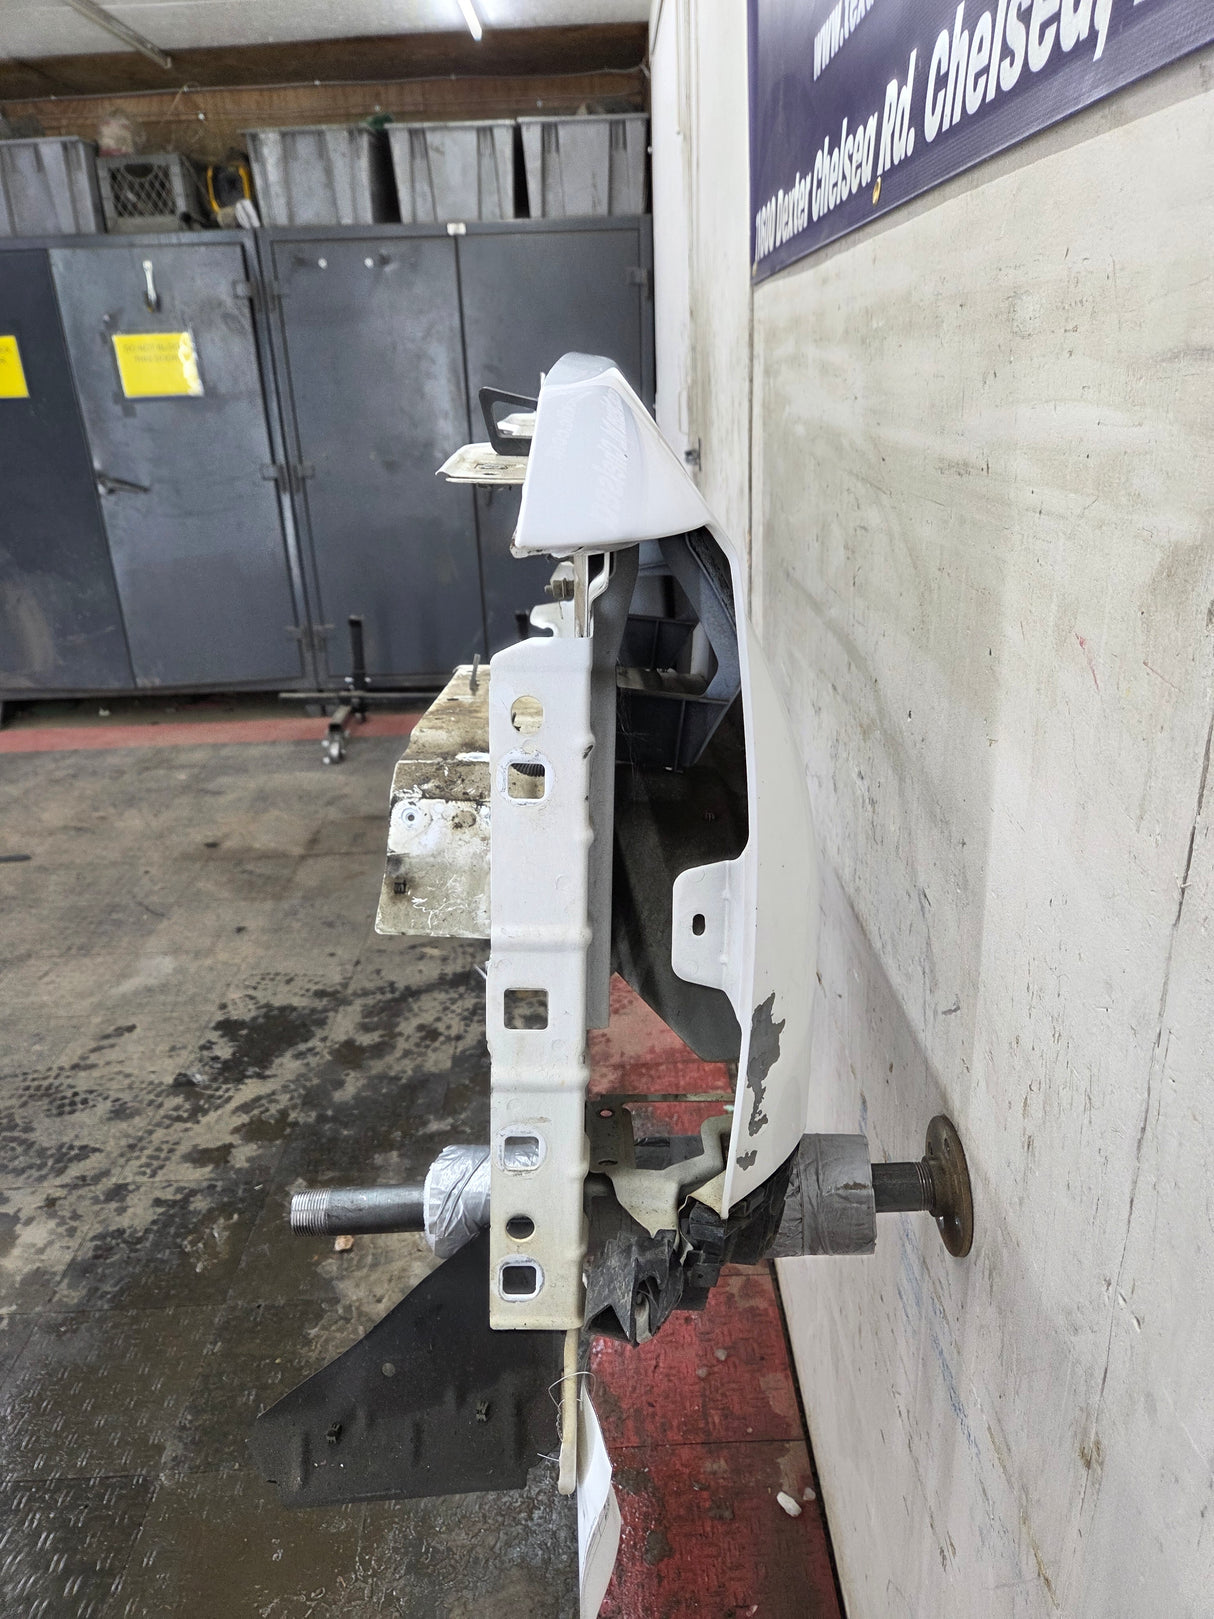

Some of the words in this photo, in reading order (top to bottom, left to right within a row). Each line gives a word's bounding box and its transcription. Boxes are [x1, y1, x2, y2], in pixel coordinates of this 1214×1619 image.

[775, 171, 812, 248] Dexter
[812, 112, 877, 222] Chelsea
[877, 48, 916, 176] Rd.
